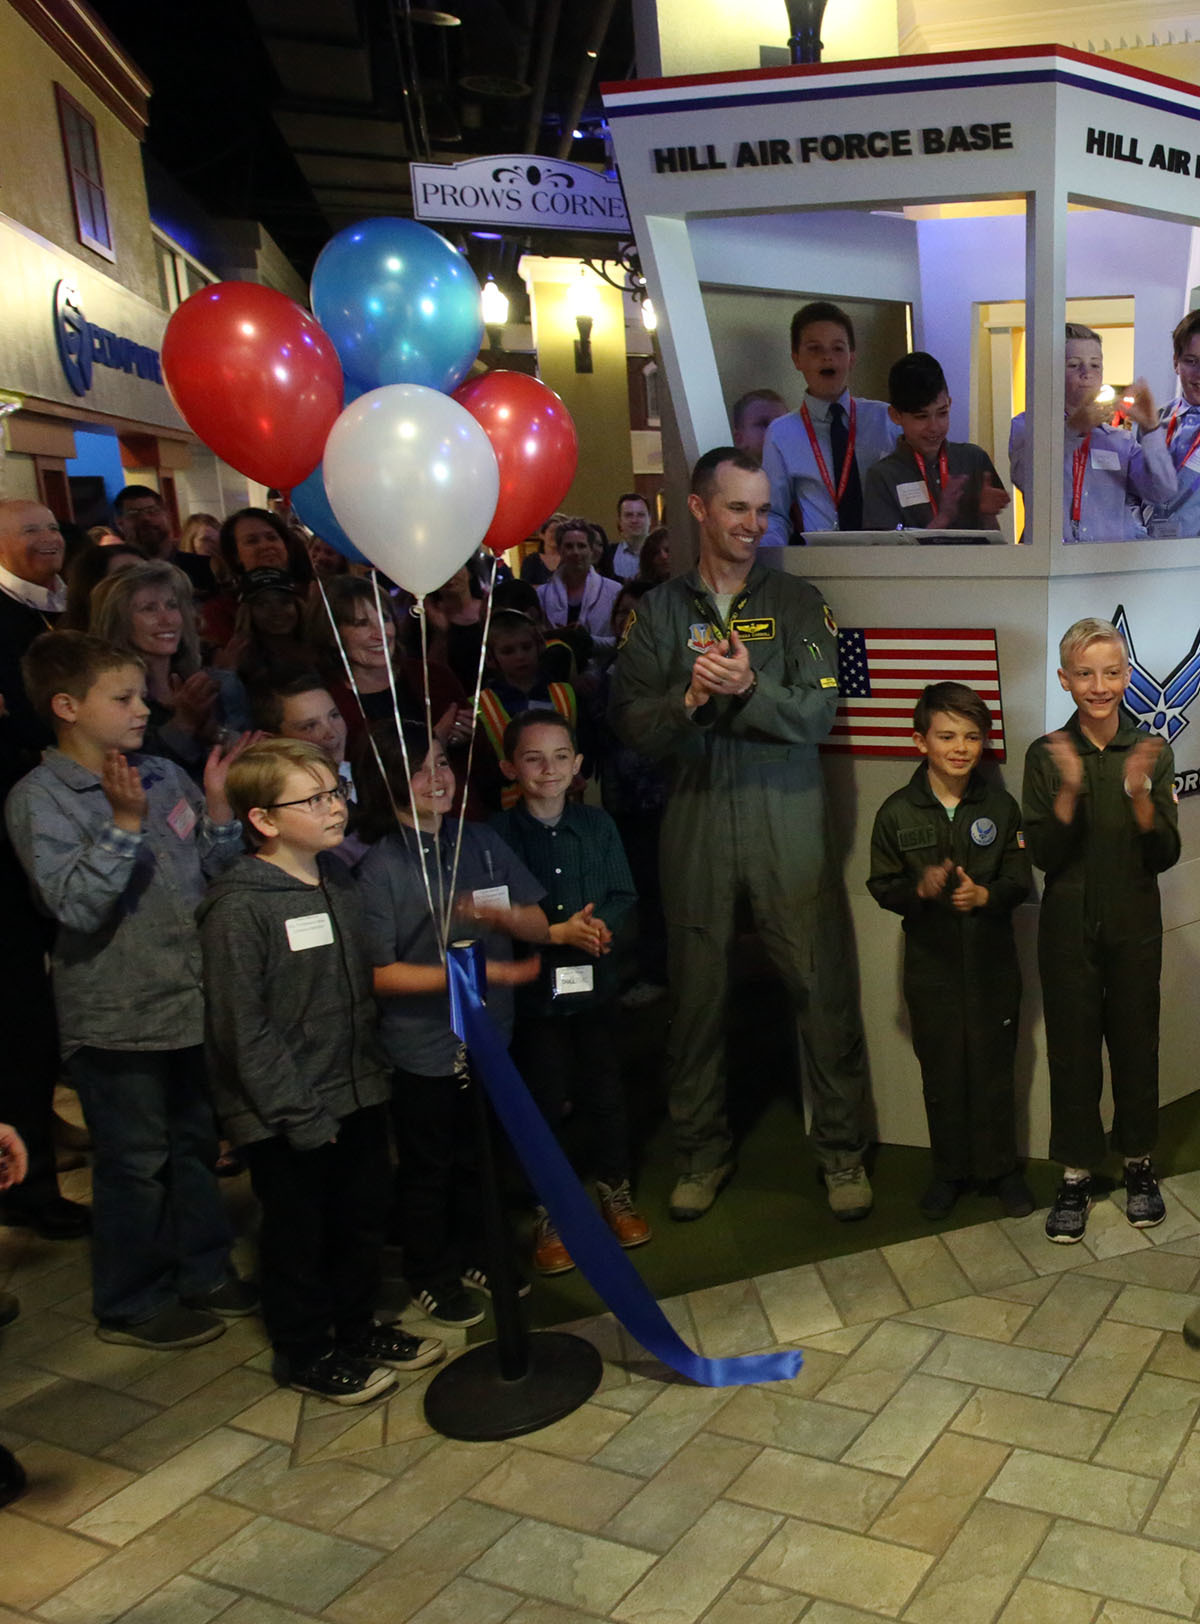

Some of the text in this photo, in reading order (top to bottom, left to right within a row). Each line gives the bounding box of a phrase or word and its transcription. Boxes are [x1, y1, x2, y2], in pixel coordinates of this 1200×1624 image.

[654, 122, 1014, 174] HILL AIR FORCE BASE
[1086, 127, 1144, 165] HILL
[1149, 143, 1191, 175] AIR
[532, 191, 629, 219] CORNE
